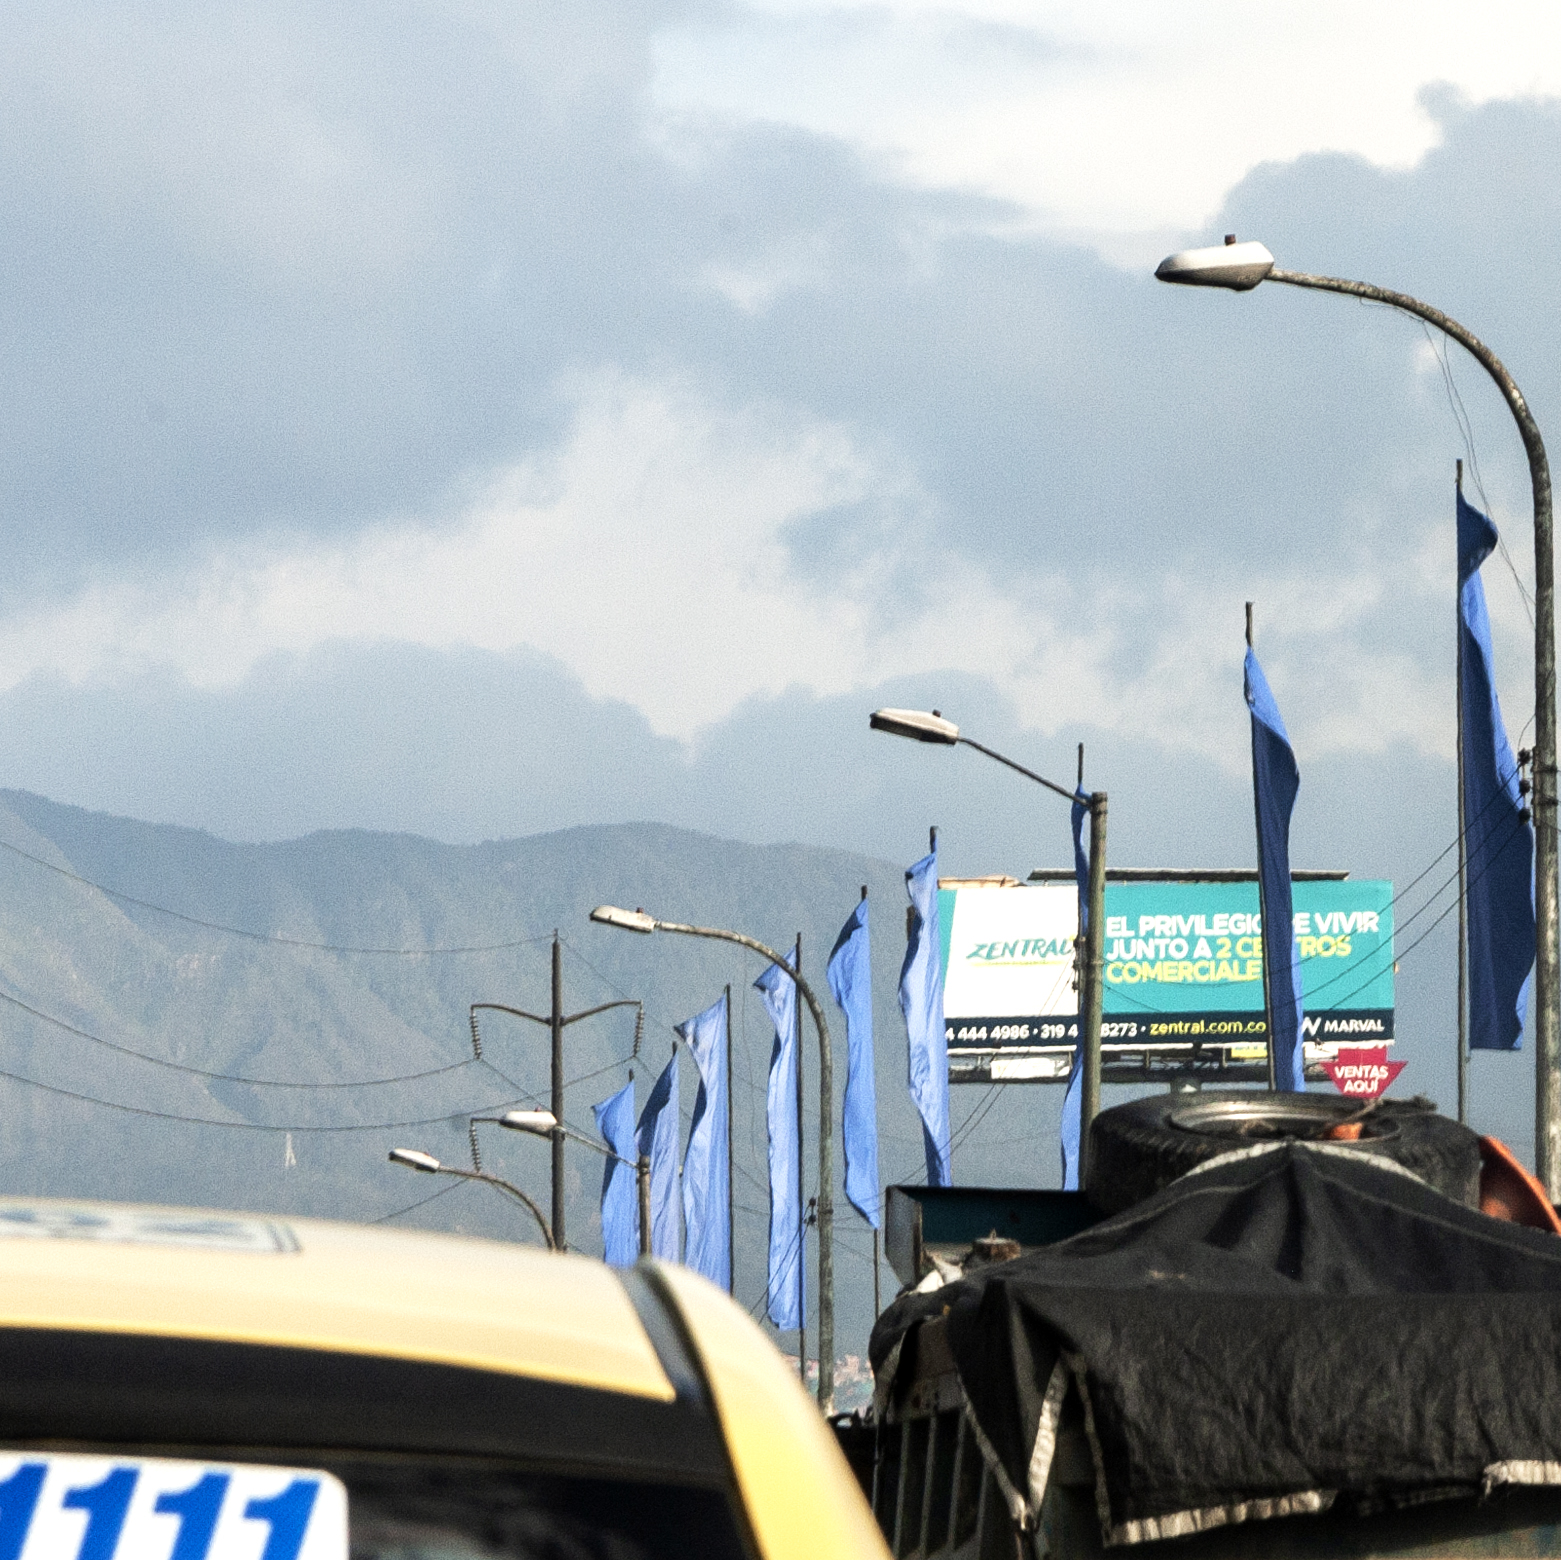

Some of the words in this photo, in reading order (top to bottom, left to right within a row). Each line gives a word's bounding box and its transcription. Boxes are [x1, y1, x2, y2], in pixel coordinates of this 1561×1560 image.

[1106, 915, 1135, 938] EL
[1292, 912, 1311, 934] E
[1314, 911, 1380, 933] VIVIR
[965, 936, 1075, 962] ZENTRAL
[1106, 937, 1189, 960] JUNTO
[1193, 937, 1213, 958] A
[1215, 936, 1232, 957] 2
[1106, 960, 1263, 984] COMERCIALE
[957, 1026, 988, 1042] 444
[990, 1024, 1030, 1041] 4986
[1040, 1023, 1066, 1039] 319
[1149, 1019, 1267, 1036] zentral.com.co
[1324, 1018, 1385, 1034] MARVAL
[1334, 1065, 1389, 1080] VENTAS
